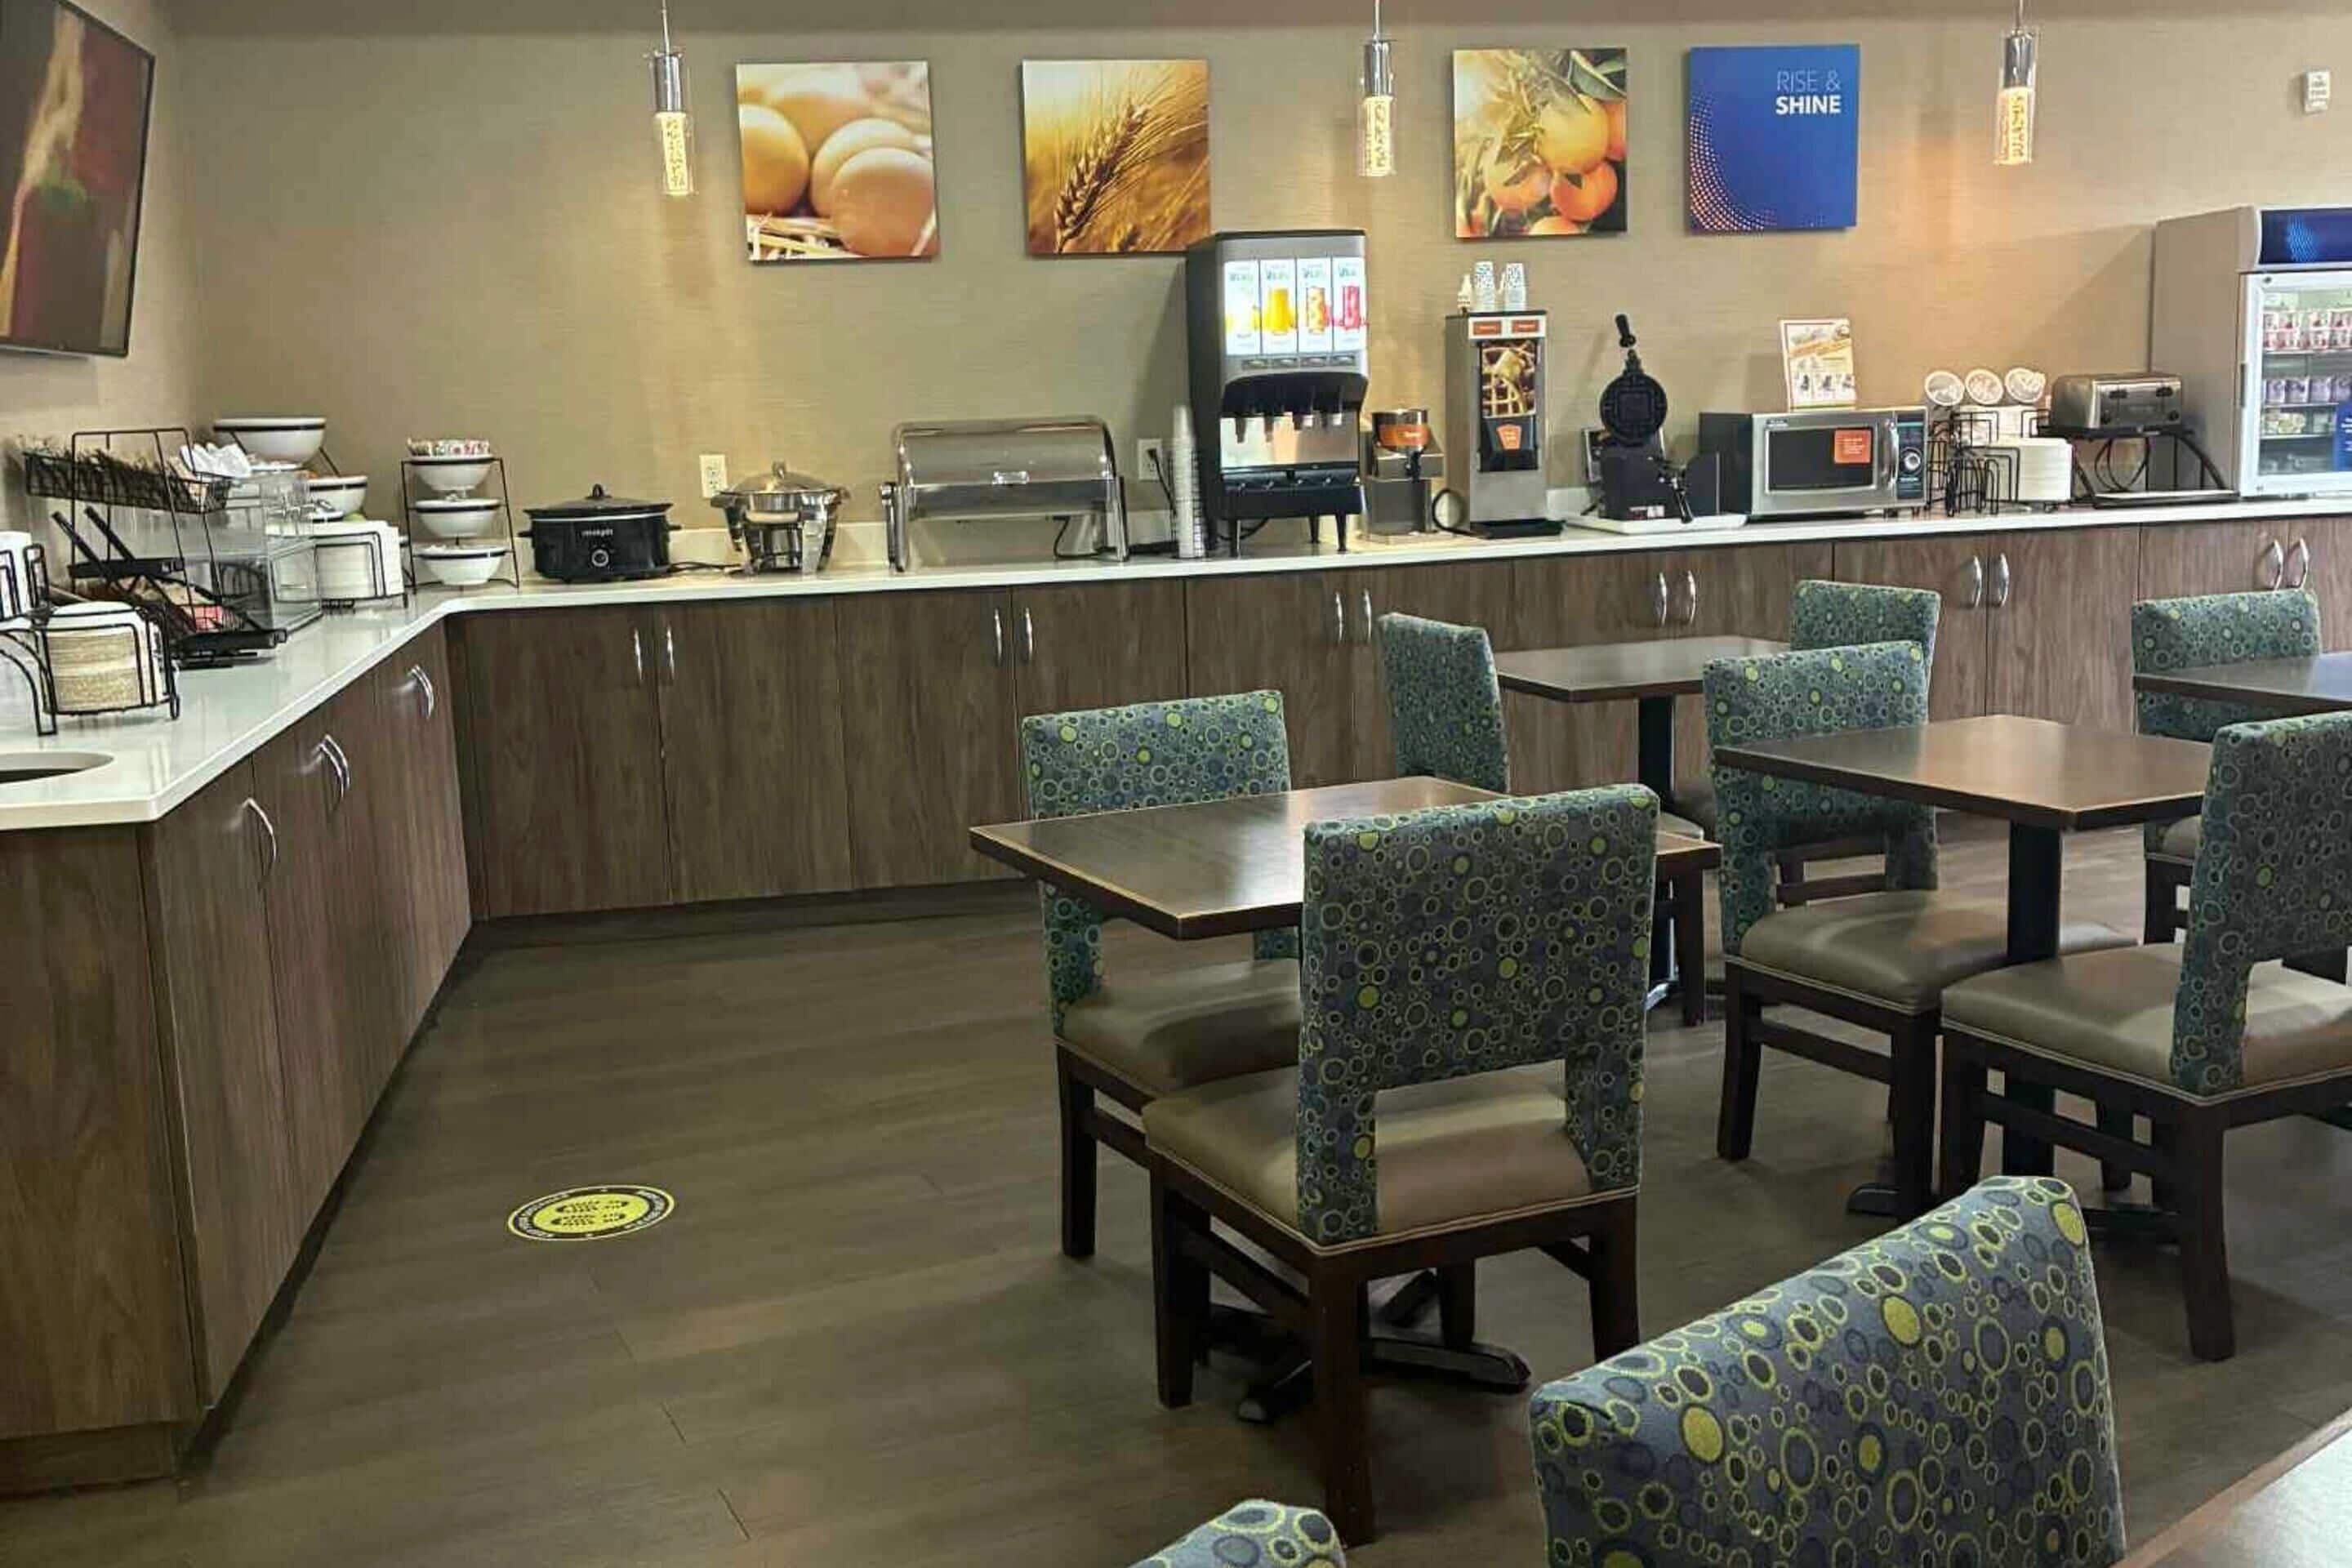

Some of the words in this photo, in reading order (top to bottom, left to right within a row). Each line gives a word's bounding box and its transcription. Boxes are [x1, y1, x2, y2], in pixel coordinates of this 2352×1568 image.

[1777, 71, 1817, 91] RISE
[1826, 71, 1841, 91] &
[1776, 95, 1841, 114] SHINE
